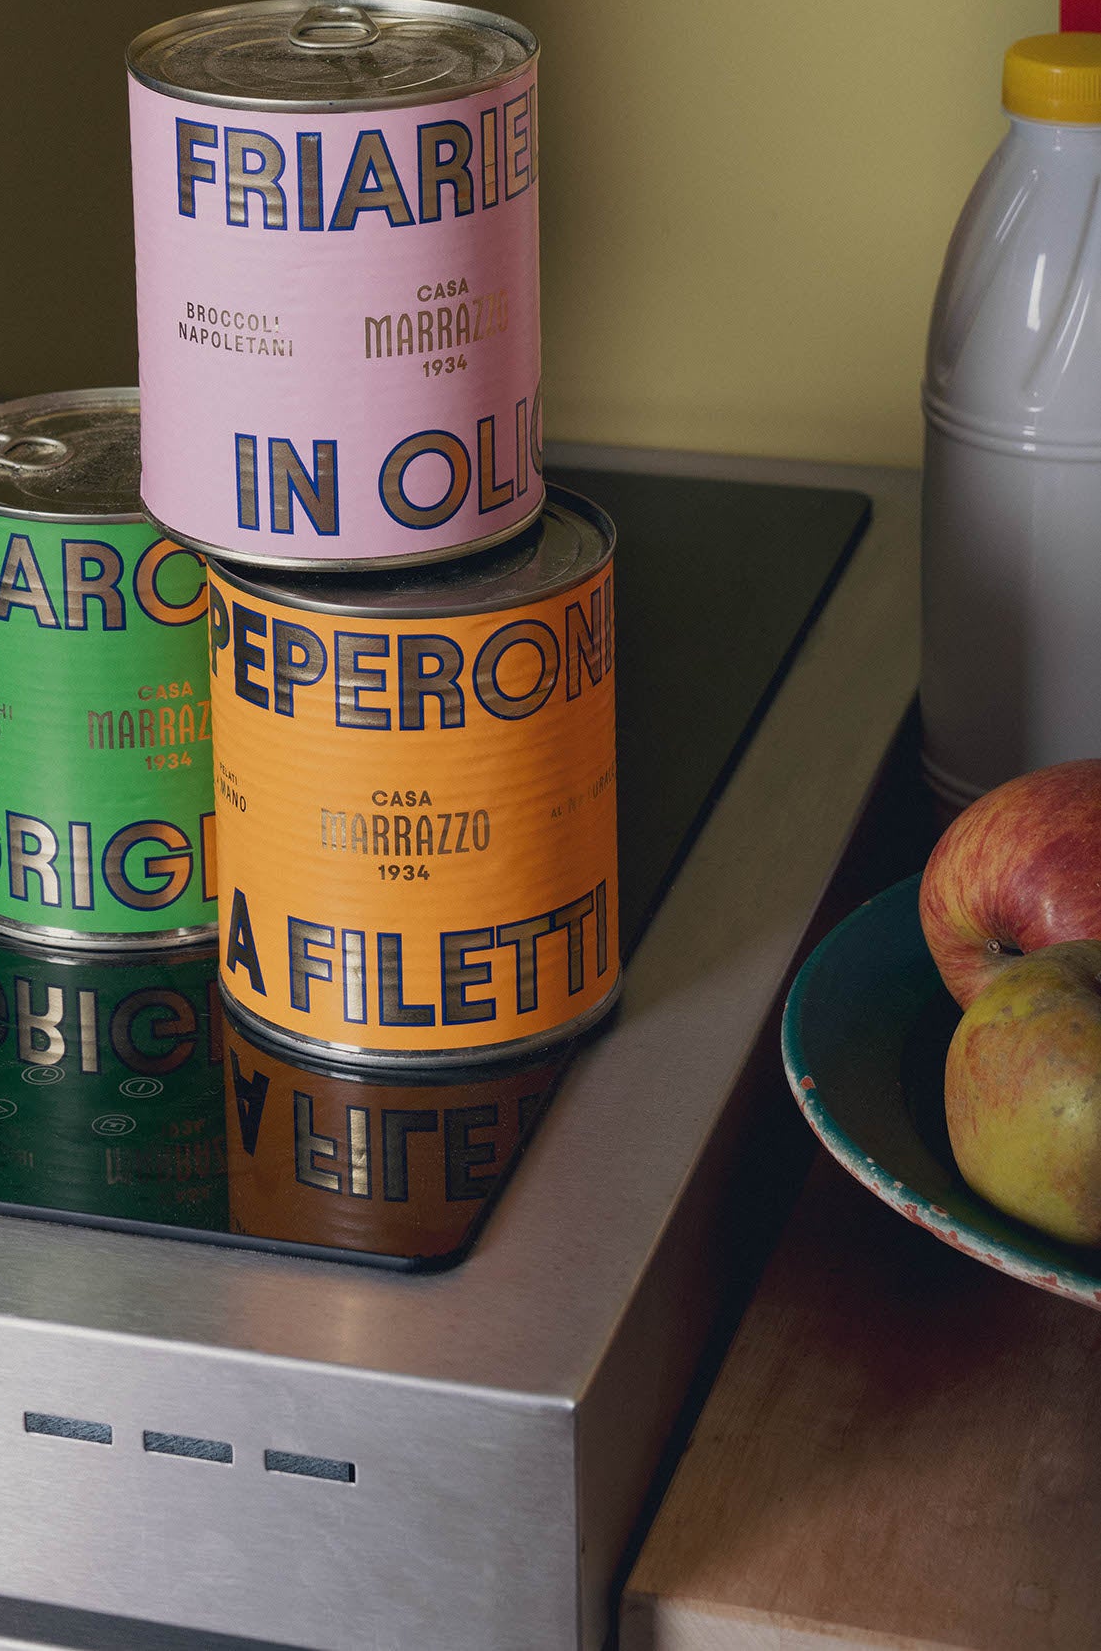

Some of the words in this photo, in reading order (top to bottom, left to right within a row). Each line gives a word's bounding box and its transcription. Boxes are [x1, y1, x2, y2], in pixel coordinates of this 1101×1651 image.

[416, 277, 469, 302] CASA
[186, 301, 279, 333] BROCCOLI
[364, 289, 509, 359] MARRAZZO
[178, 321, 293, 357] NAPOLETANI
[422, 353, 468, 378] 1934
[234, 432, 340, 537] IN
[209, 575, 612, 731] PEPERONI
[137, 680, 194, 701] CASA
[144, 751, 192, 771] 1934
[371, 790, 433, 807] CASA
[321, 808, 490, 856] MARRAZZO
[377, 864, 430, 881] 1934
[226, 887, 267, 997] A
[287, 878, 607, 1027] FILETTI
